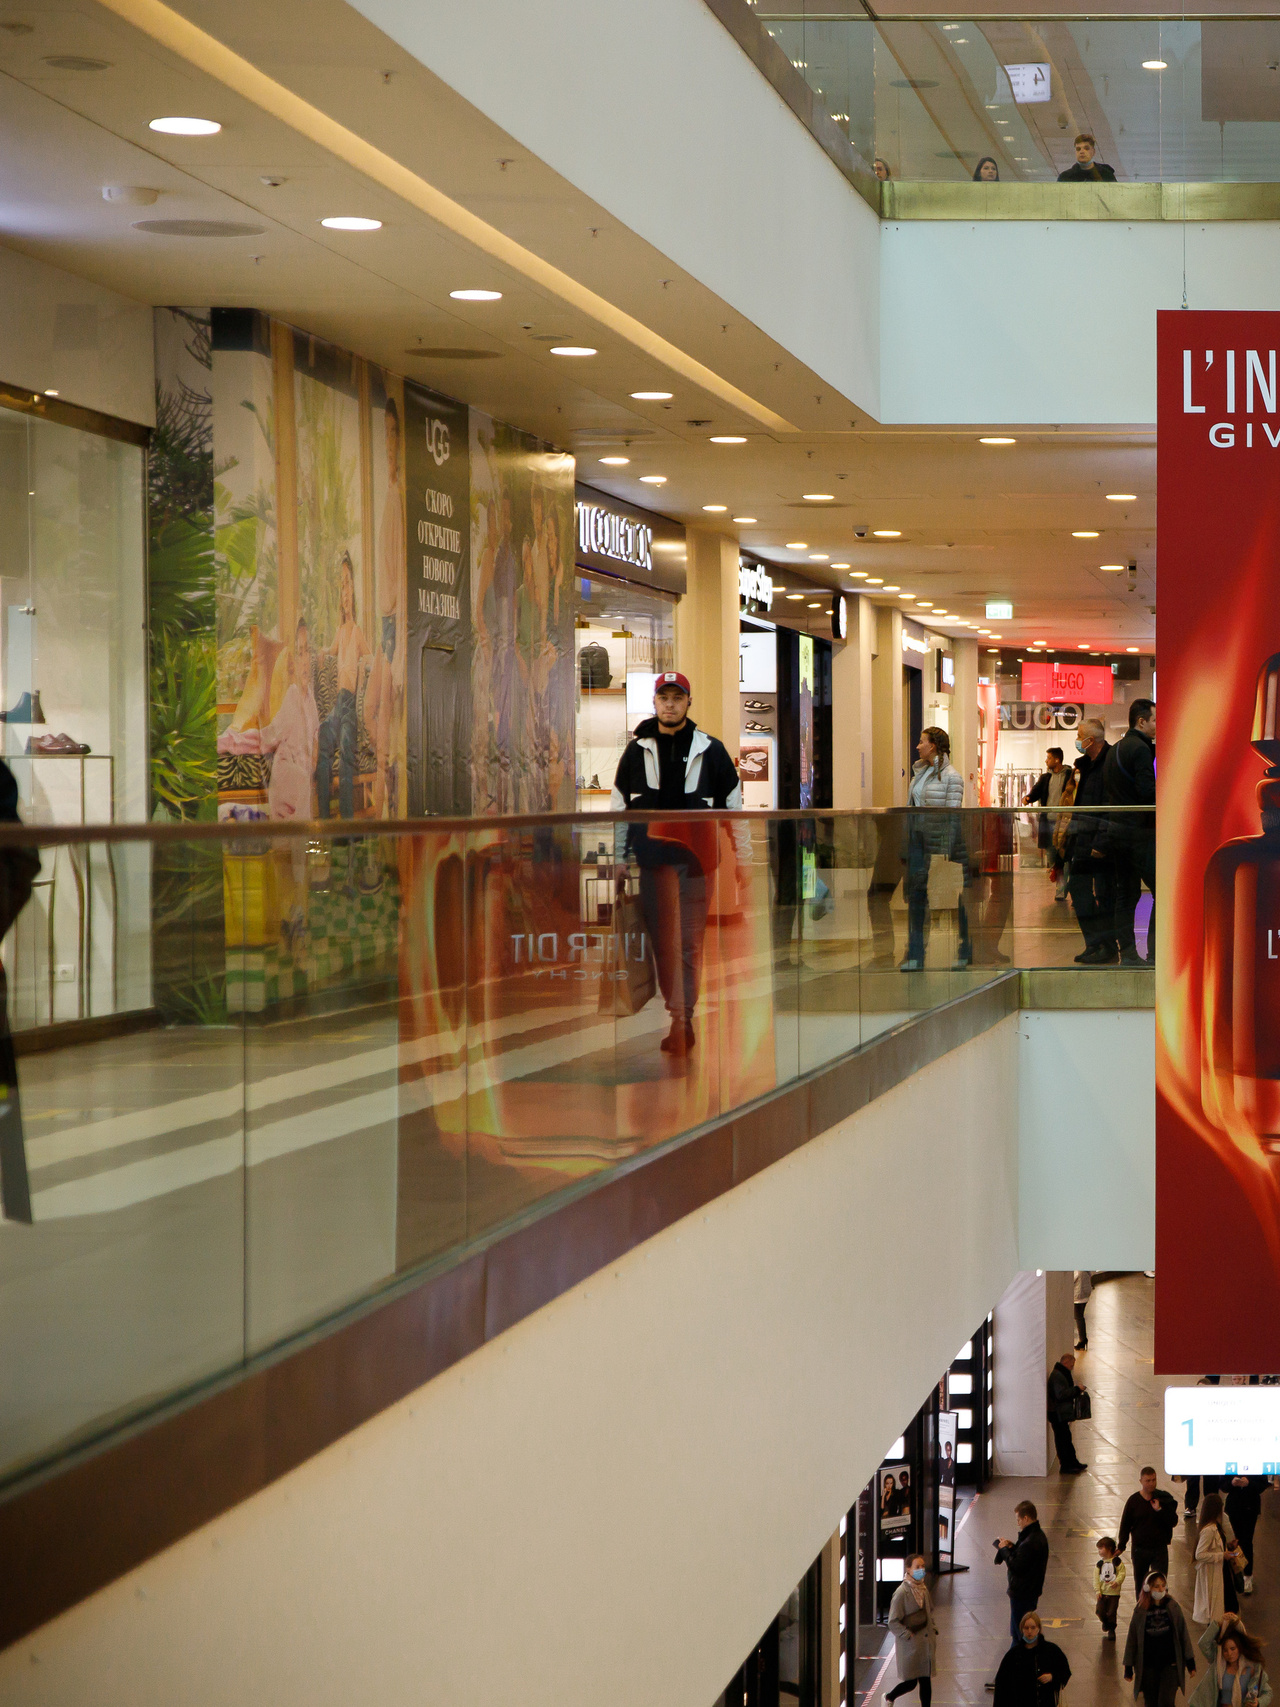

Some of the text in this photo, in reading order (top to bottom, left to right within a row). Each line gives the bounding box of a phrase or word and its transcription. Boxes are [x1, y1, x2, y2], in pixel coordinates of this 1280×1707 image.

[425, 417, 450, 466] UGG
[425, 488, 453, 518] СКОРО
[417, 519, 461, 554] ОТКРЫТИЕ
[423, 555, 455, 586] НОВОГО
[418, 588, 460, 620] МАГАЗИНА
[1051, 672, 1085, 690] HUGO
[1181, 1418, 1194, 1447] 1
[884, 1527, 908, 1536] CHANEL
